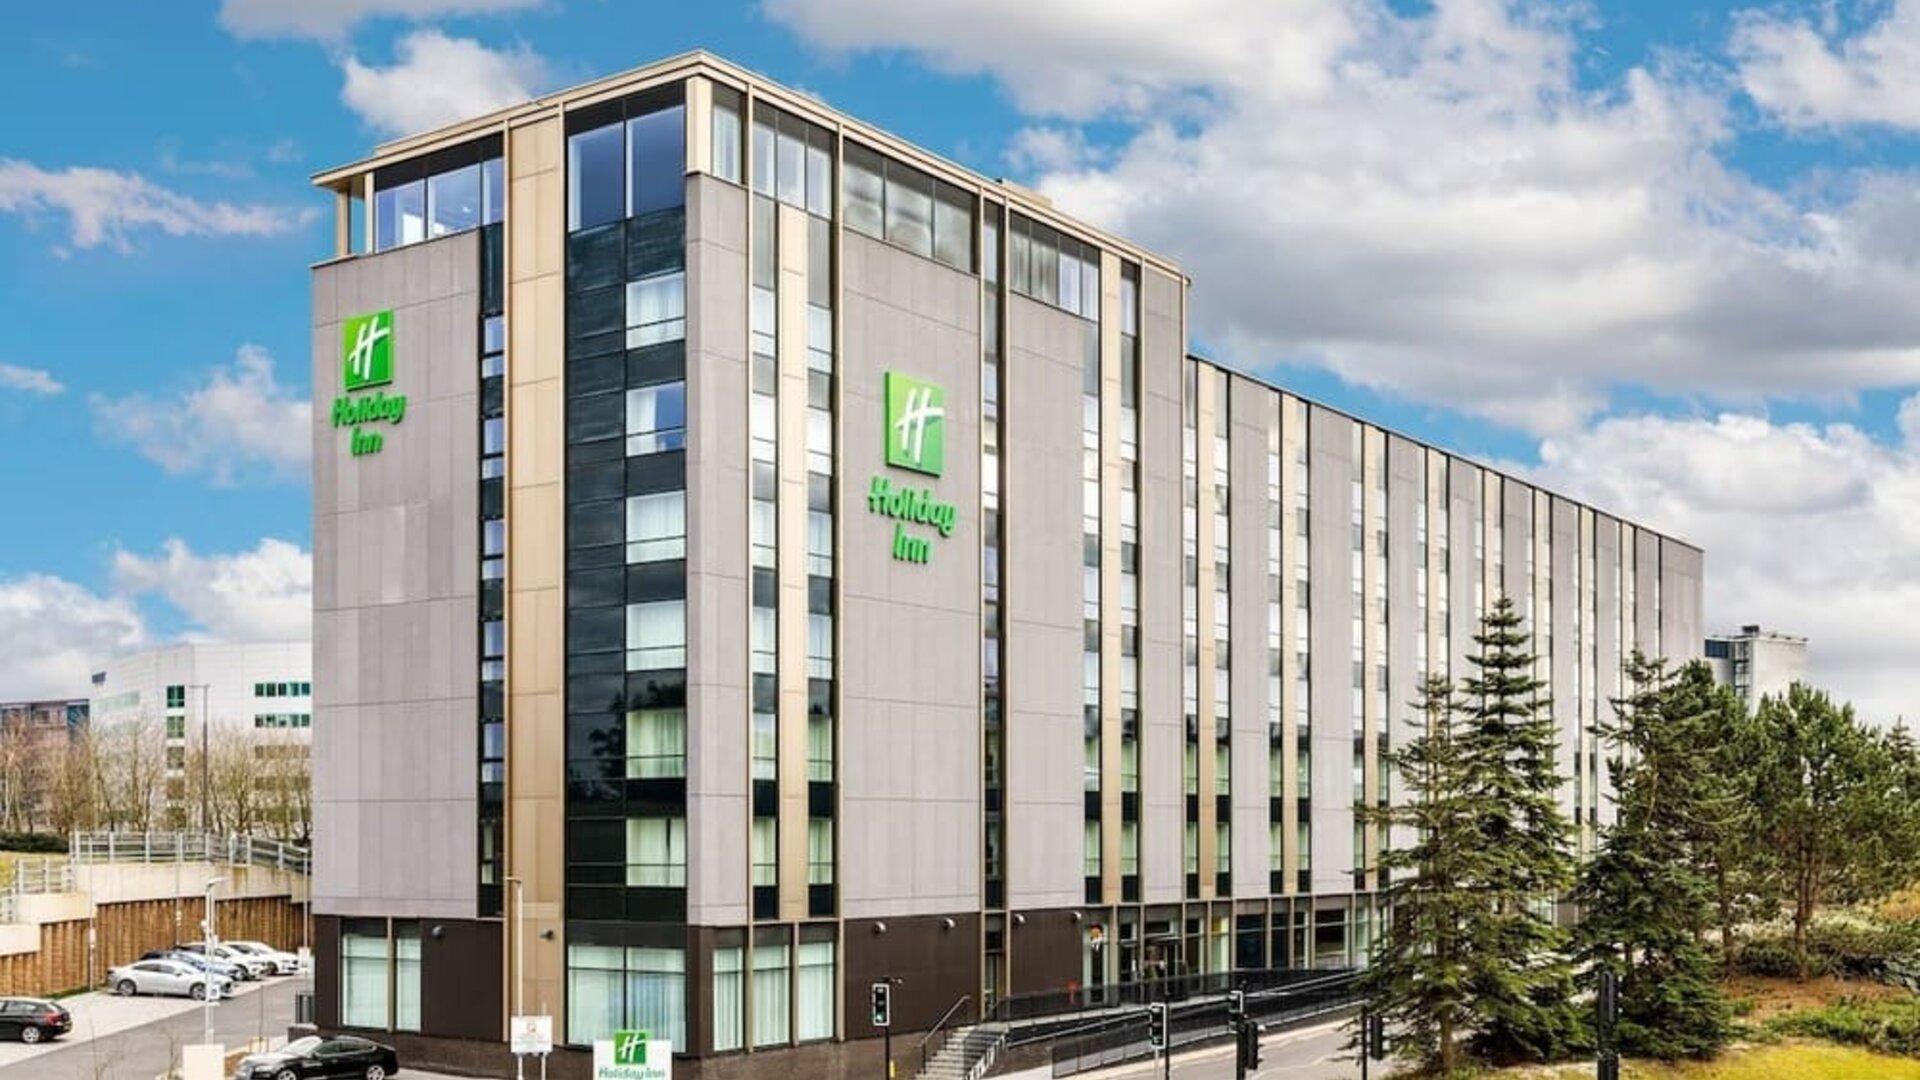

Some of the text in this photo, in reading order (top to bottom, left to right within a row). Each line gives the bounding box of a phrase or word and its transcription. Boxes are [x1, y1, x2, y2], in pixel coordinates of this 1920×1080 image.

[348, 316, 391, 380] H
[332, 391, 407, 428] Holiday
[895, 387, 945, 464] H
[351, 426, 383, 456] Inn
[868, 476, 955, 538] Holiday
[892, 522, 929, 565] Inn
[616, 1034, 647, 1062] H
[599, 1067, 665, 1080] Holiday Inn
